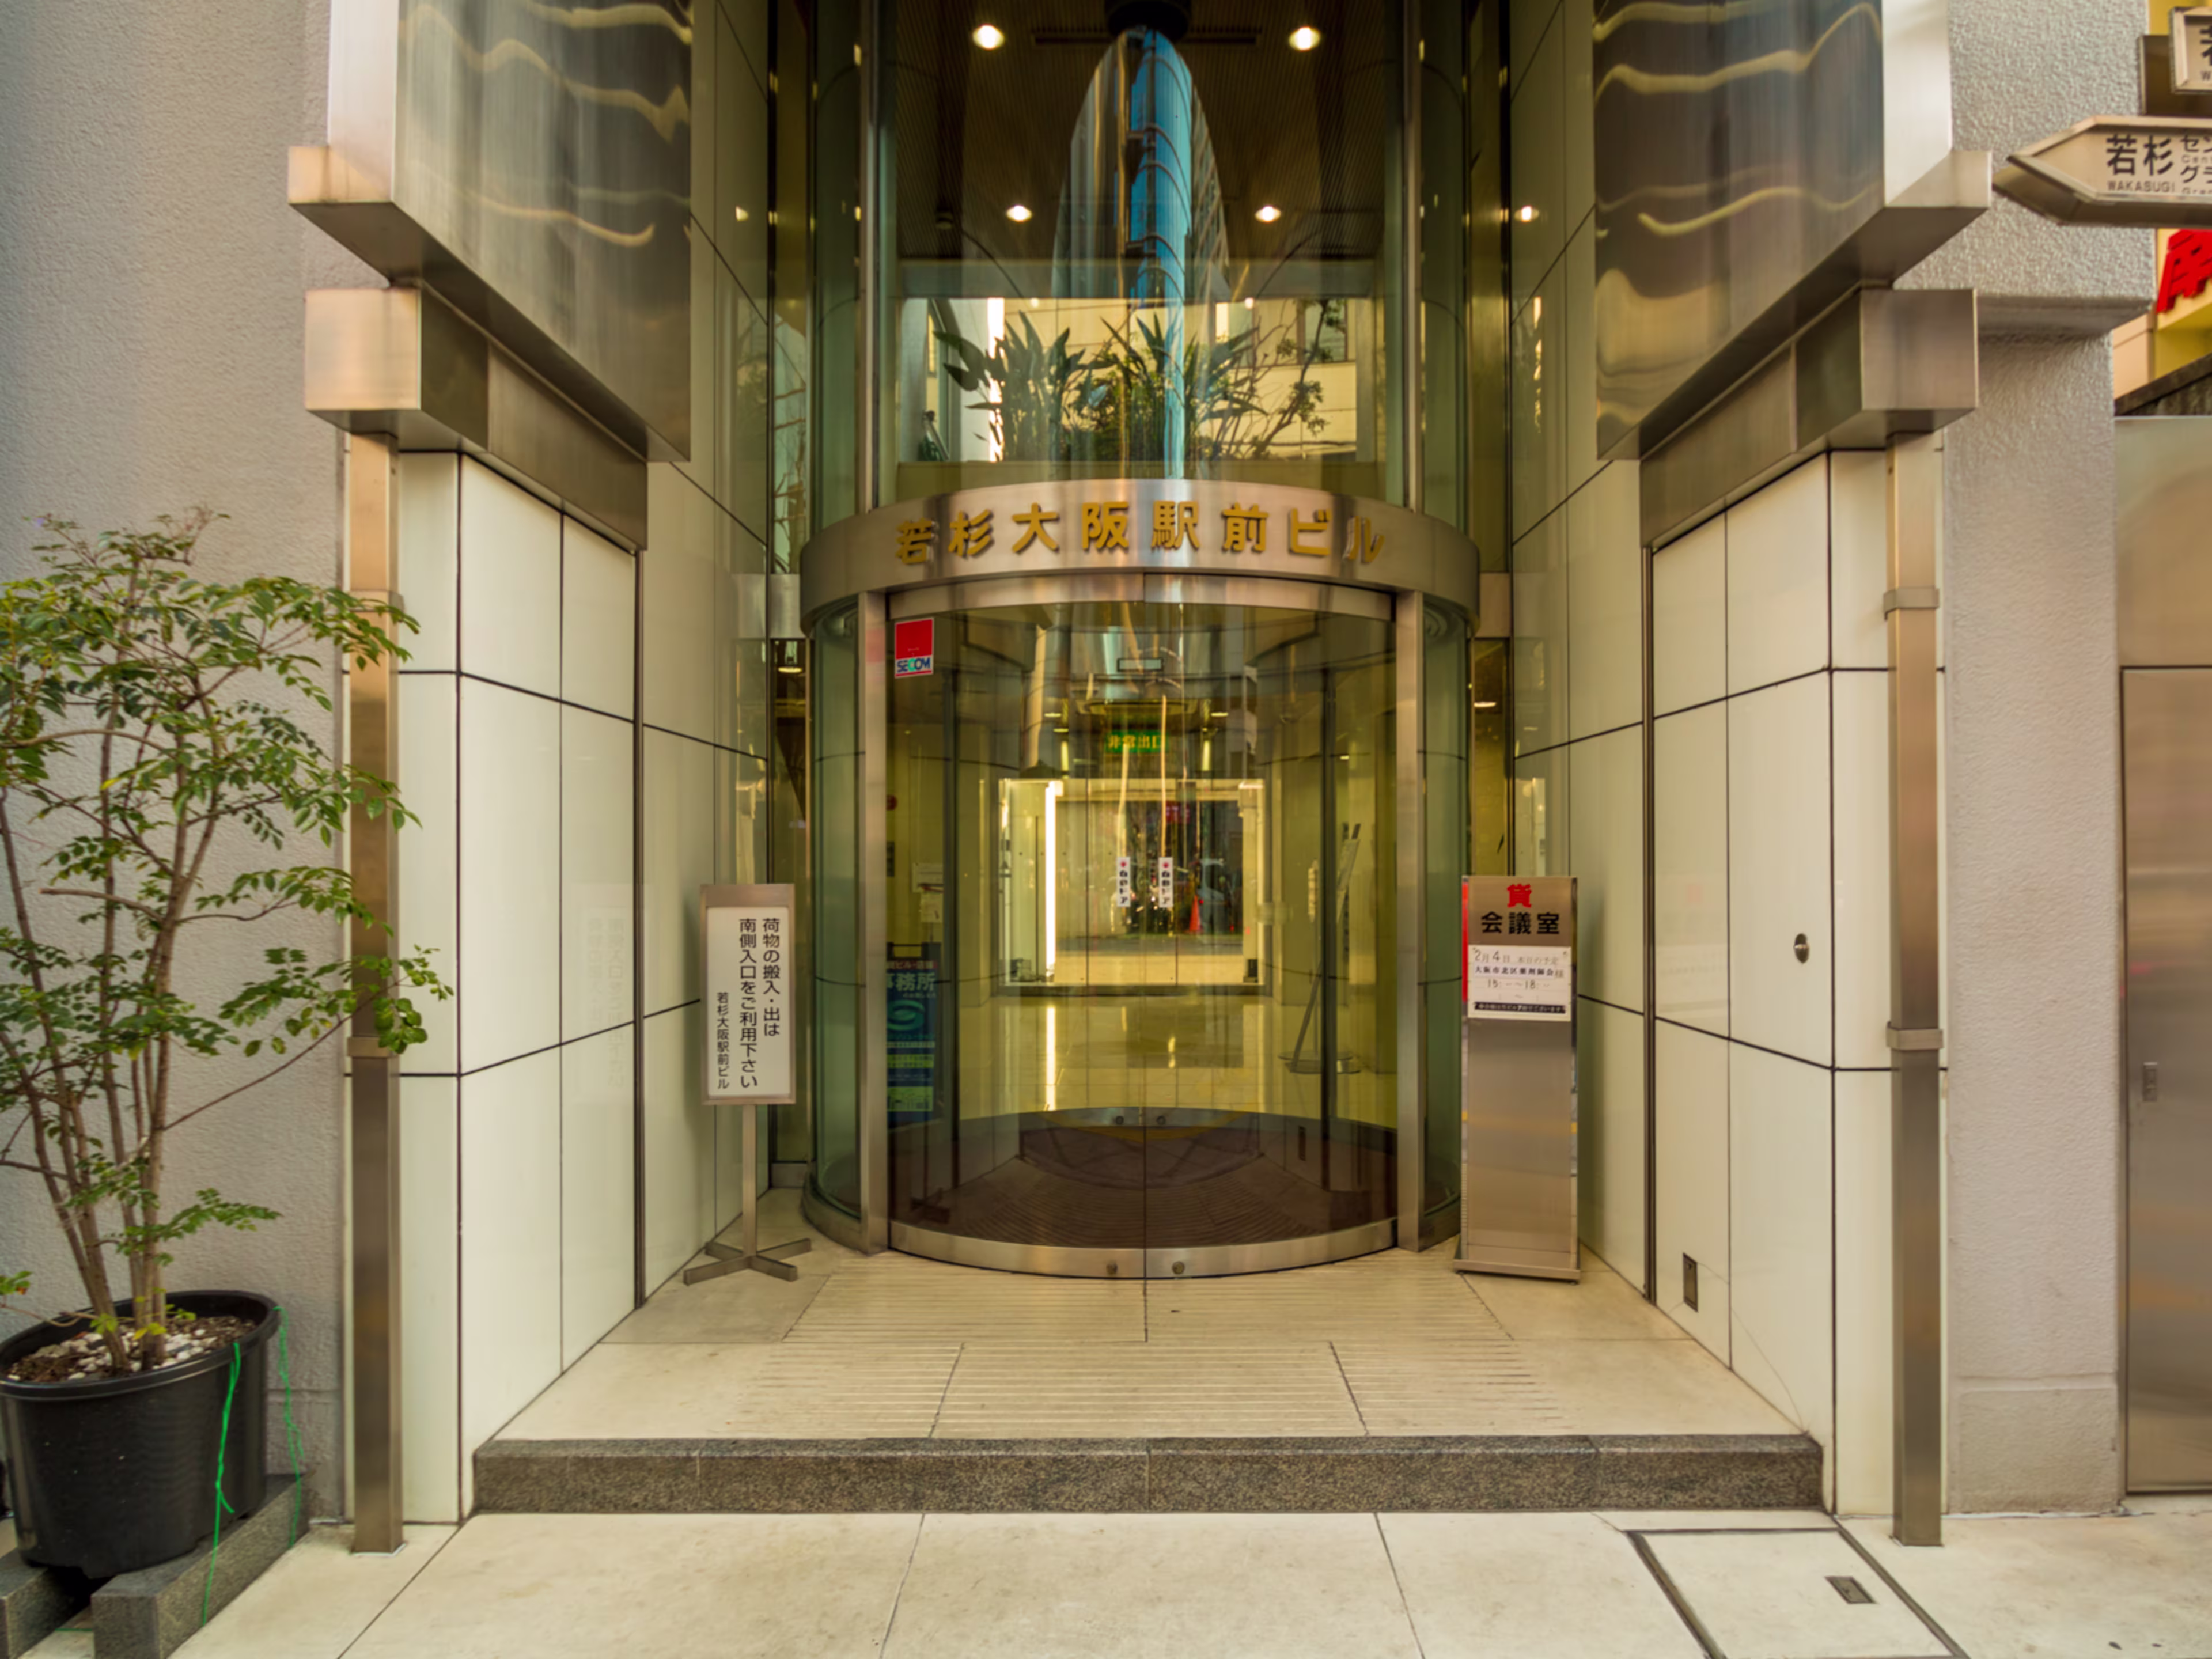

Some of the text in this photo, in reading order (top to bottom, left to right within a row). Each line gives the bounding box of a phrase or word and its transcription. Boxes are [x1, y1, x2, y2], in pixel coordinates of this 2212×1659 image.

[2106, 134, 2173, 176] 若杉
[2107, 180, 2176, 192] WAKASUGI
[896, 500, 1384, 565] 若杉大阪駅前ビル
[896, 657, 930, 673] SECOM
[1481, 911, 1560, 935] 会議室
[738, 918, 758, 1089] 南側入口をご利用下さい
[762, 918, 781, 1037] 荷物の搬入・出は
[717, 992, 730, 1089] 若杉大阪駅前ビル
